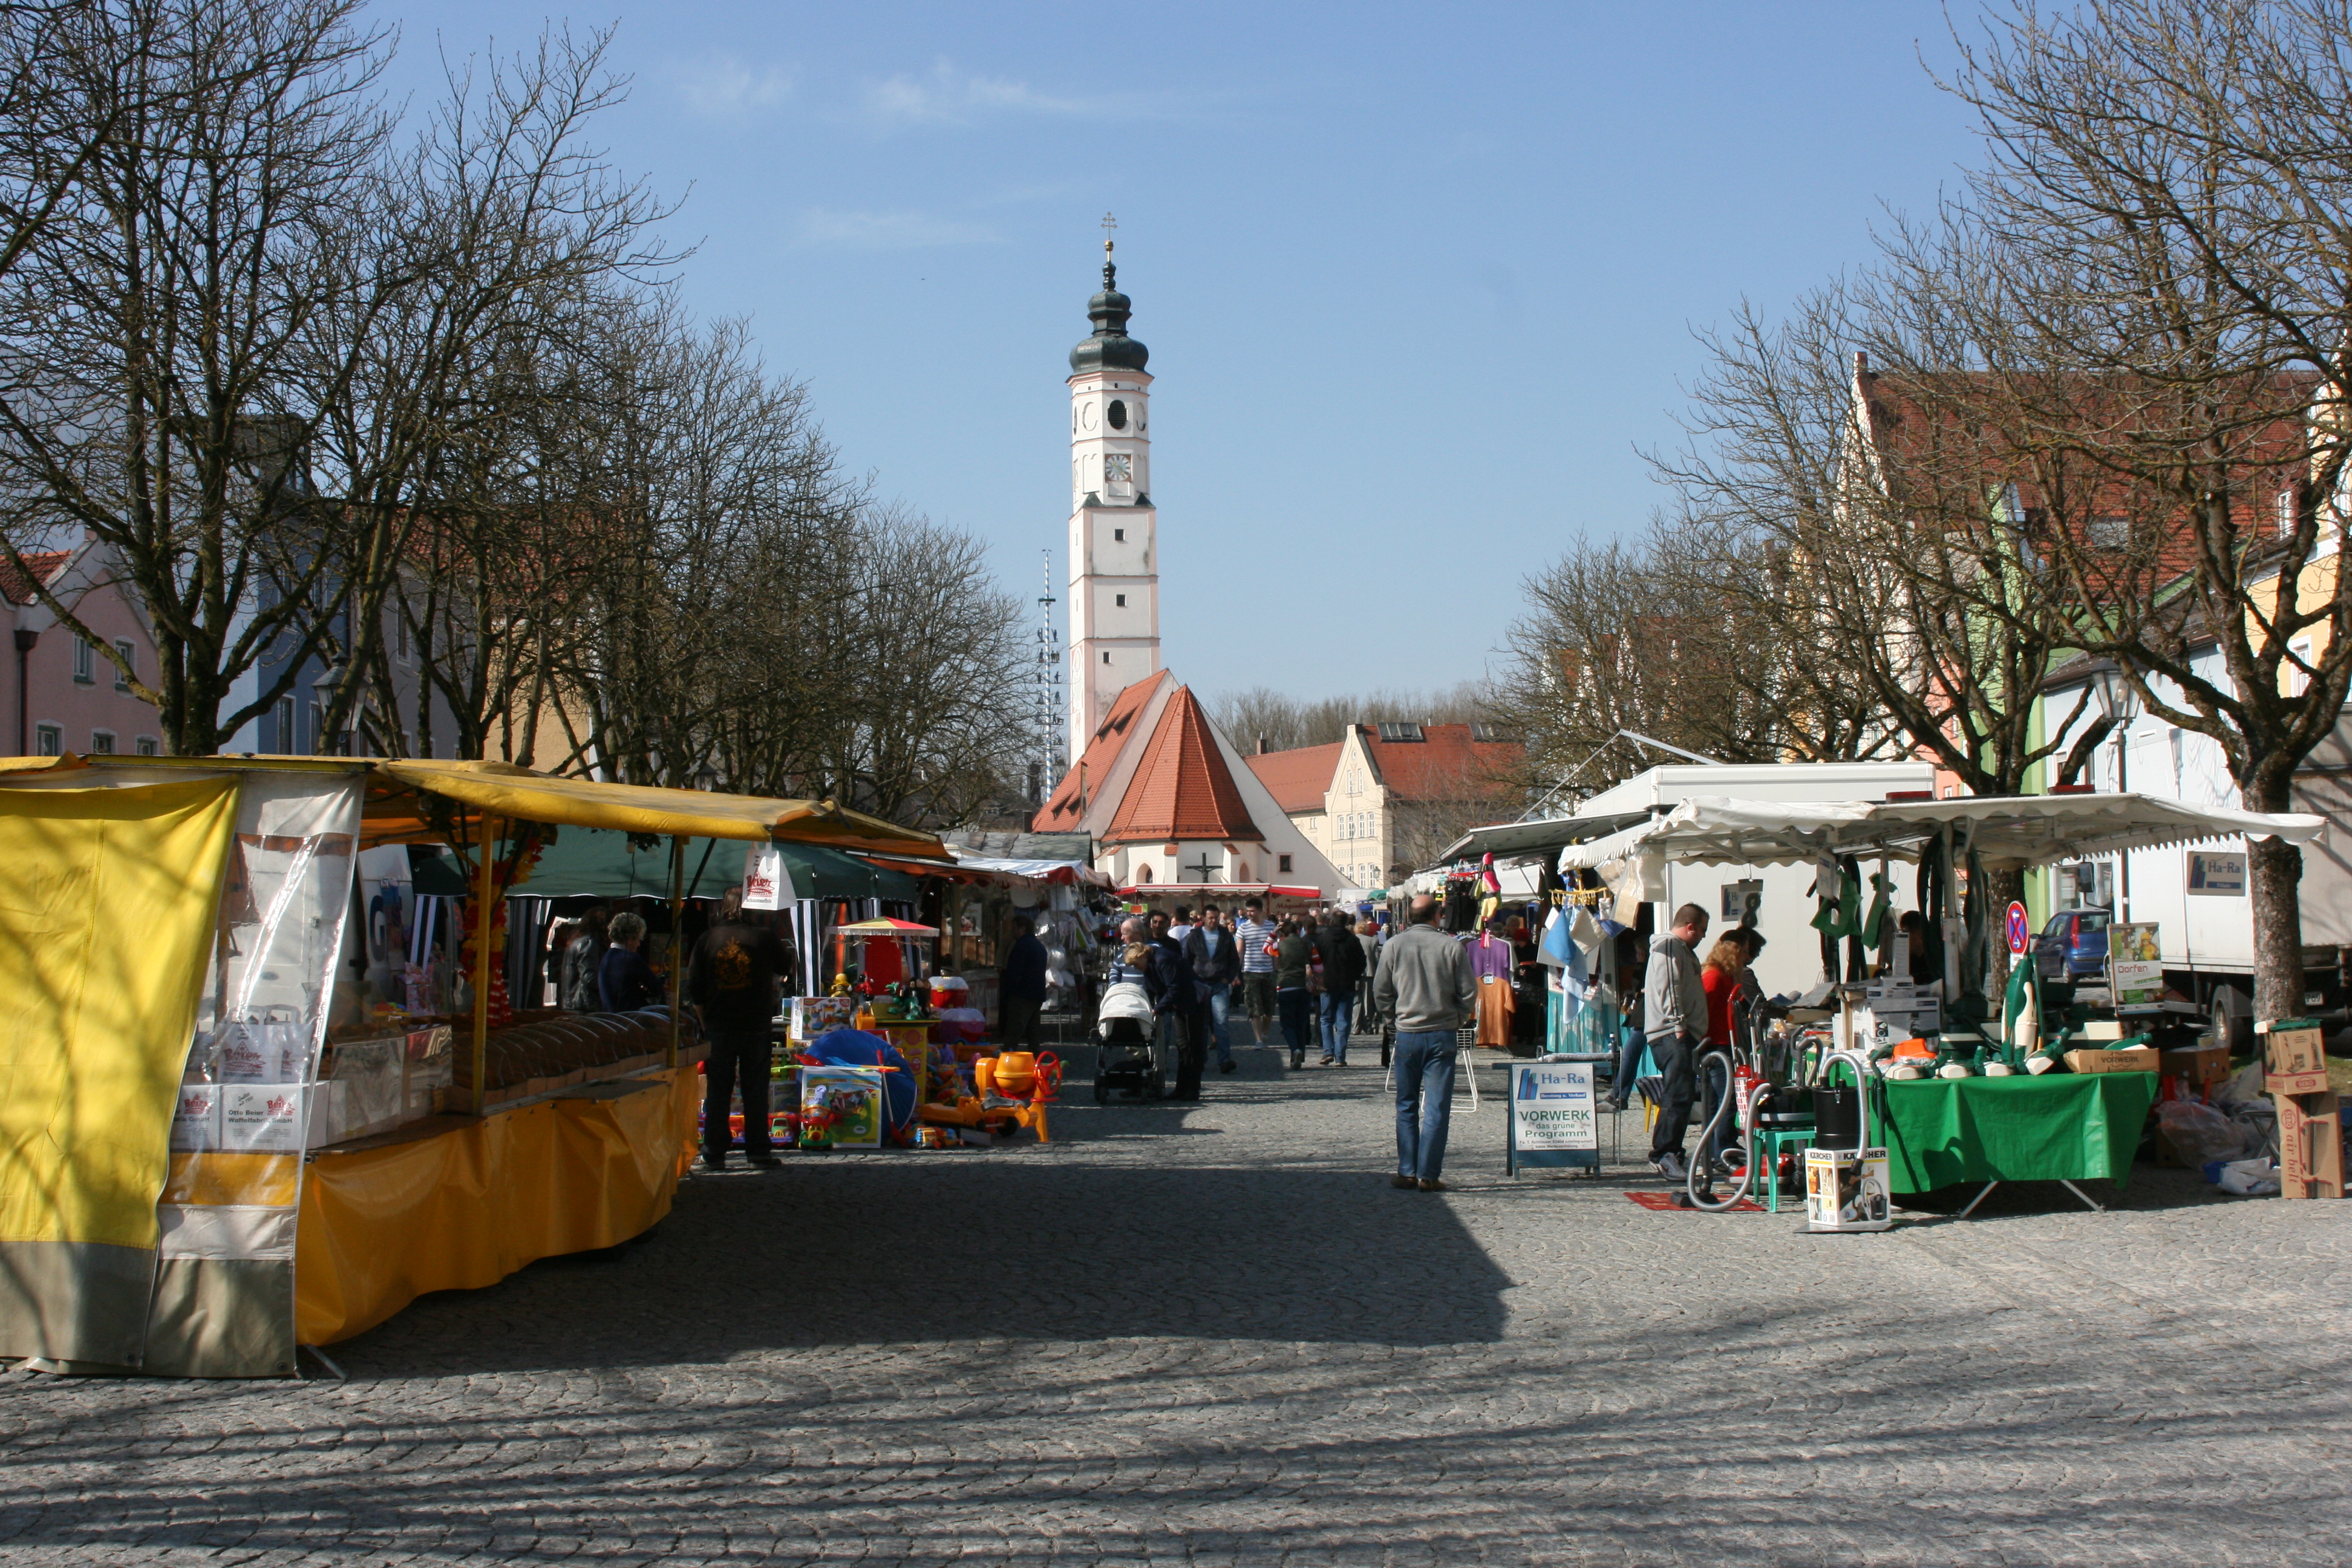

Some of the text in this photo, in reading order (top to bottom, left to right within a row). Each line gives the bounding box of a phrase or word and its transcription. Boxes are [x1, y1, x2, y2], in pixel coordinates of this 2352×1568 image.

[2208, 861, 2240, 873] Ha-Ra
[2118, 964, 2148, 973] Dorfen
[1541, 1073, 1585, 1084] Ha-Ra
[2298, 1079, 2313, 1088] SEBO
[1518, 1109, 1591, 1122] VORWERK
[1552, 1122, 1575, 1131] grüne
[1525, 1129, 1587, 1139] Programm
[2286, 1135, 2299, 1183] air belt
